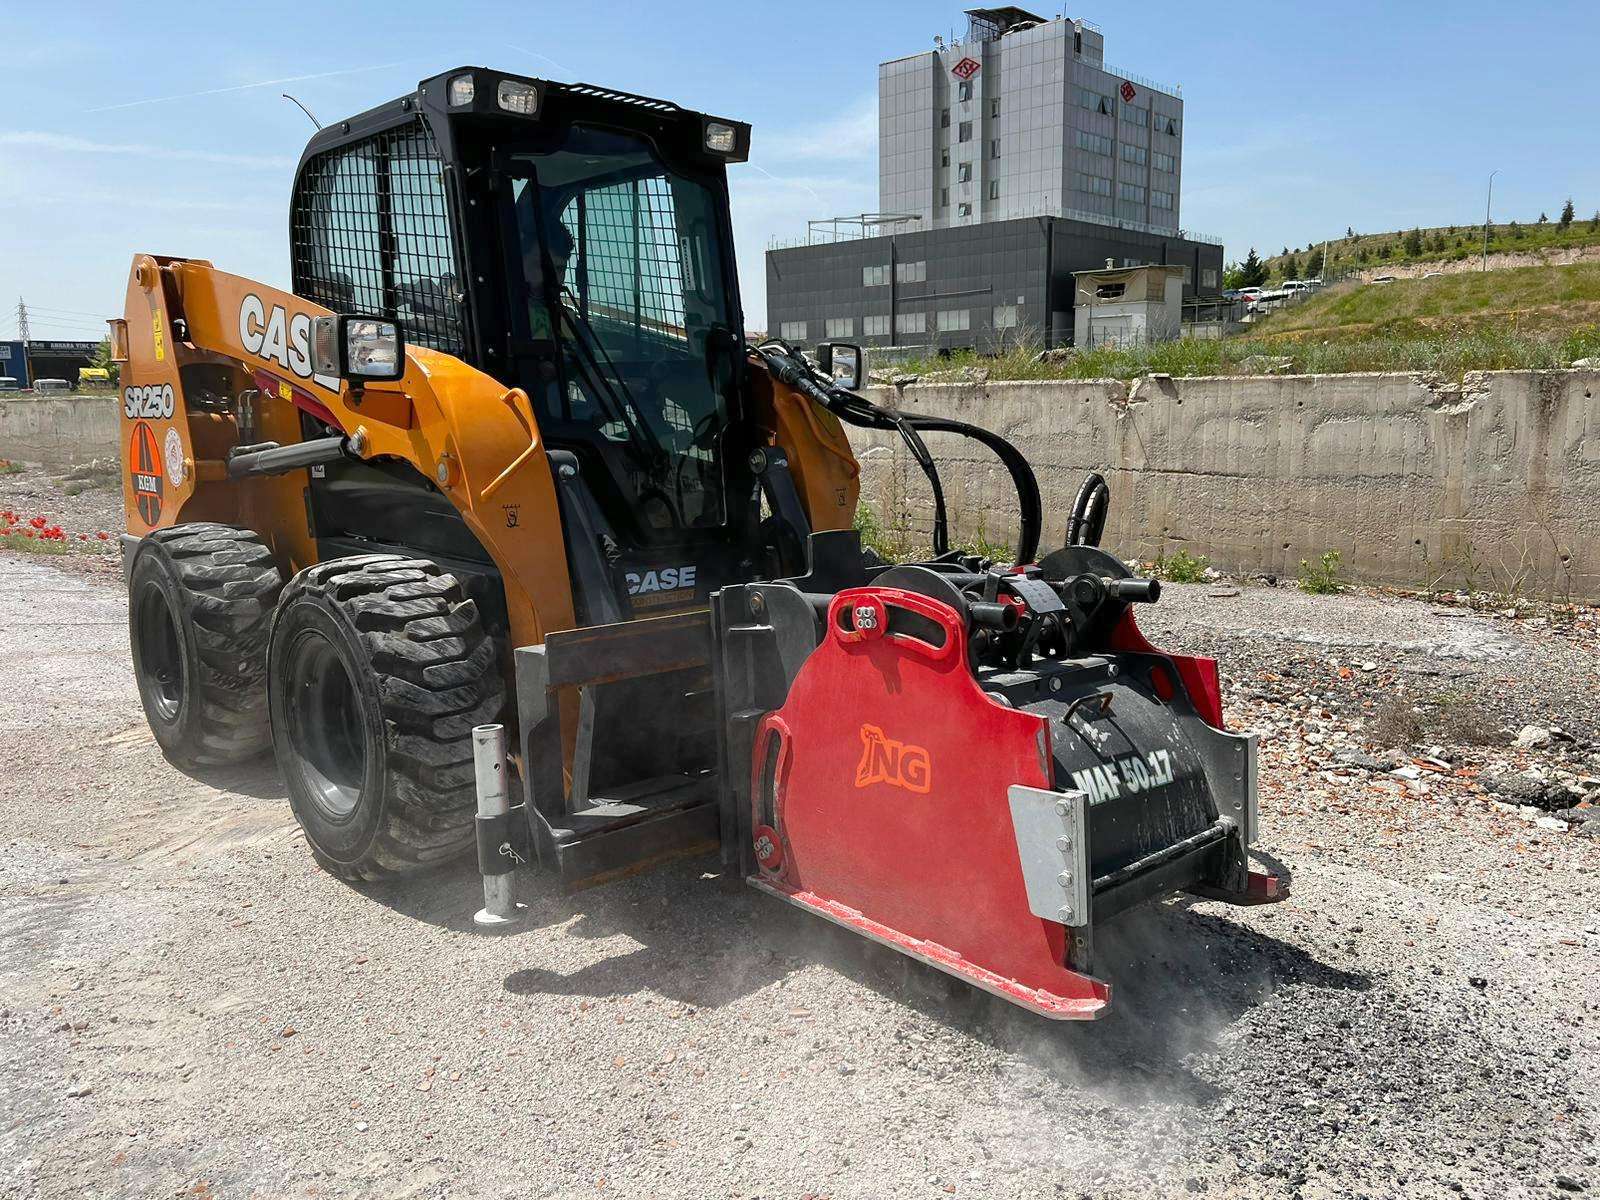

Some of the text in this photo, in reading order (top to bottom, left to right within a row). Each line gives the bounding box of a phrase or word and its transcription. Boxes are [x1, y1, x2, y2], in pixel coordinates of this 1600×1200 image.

[239, 293, 341, 395] CAS
[124, 383, 175, 420] SR250
[138, 474, 157, 493] KGM
[625, 566, 697, 595] CASE
[1071, 749, 1175, 807] MAF 50.17
